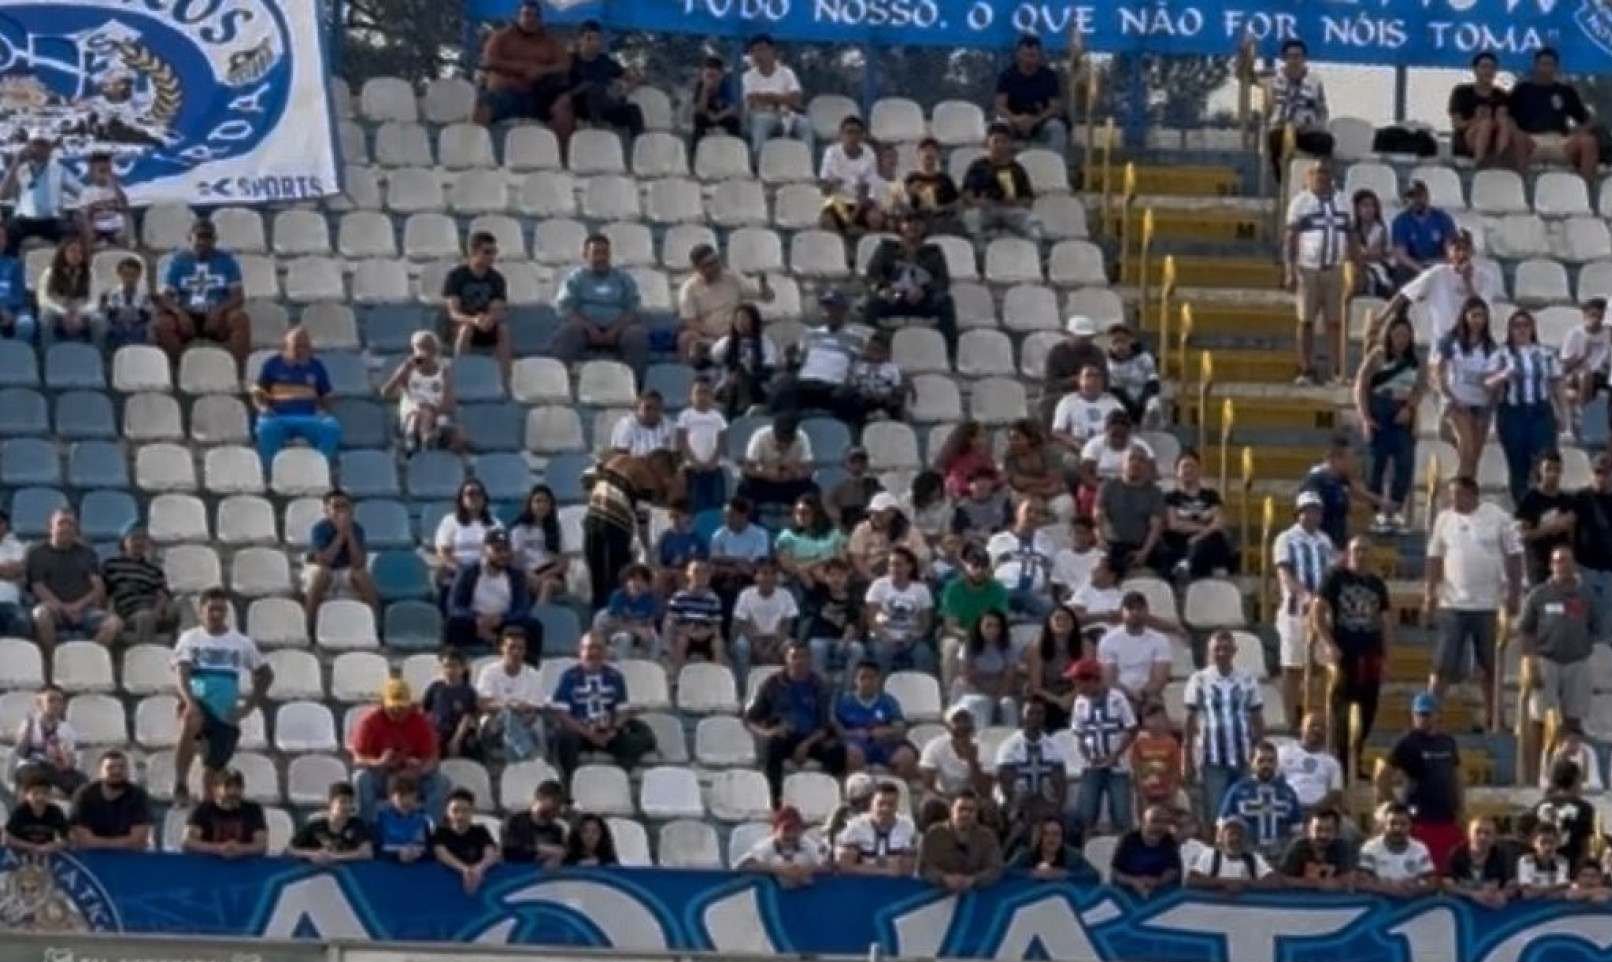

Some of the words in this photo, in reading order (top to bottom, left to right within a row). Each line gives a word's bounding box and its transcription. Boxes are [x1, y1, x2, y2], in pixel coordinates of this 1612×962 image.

[966, 4, 993, 30] O
[1013, 4, 1096, 34] QUE
[1119, 3, 1200, 36] NÃO
[1224, 10, 1298, 40] FOR
[1320, 12, 1408, 47] NÓIS
